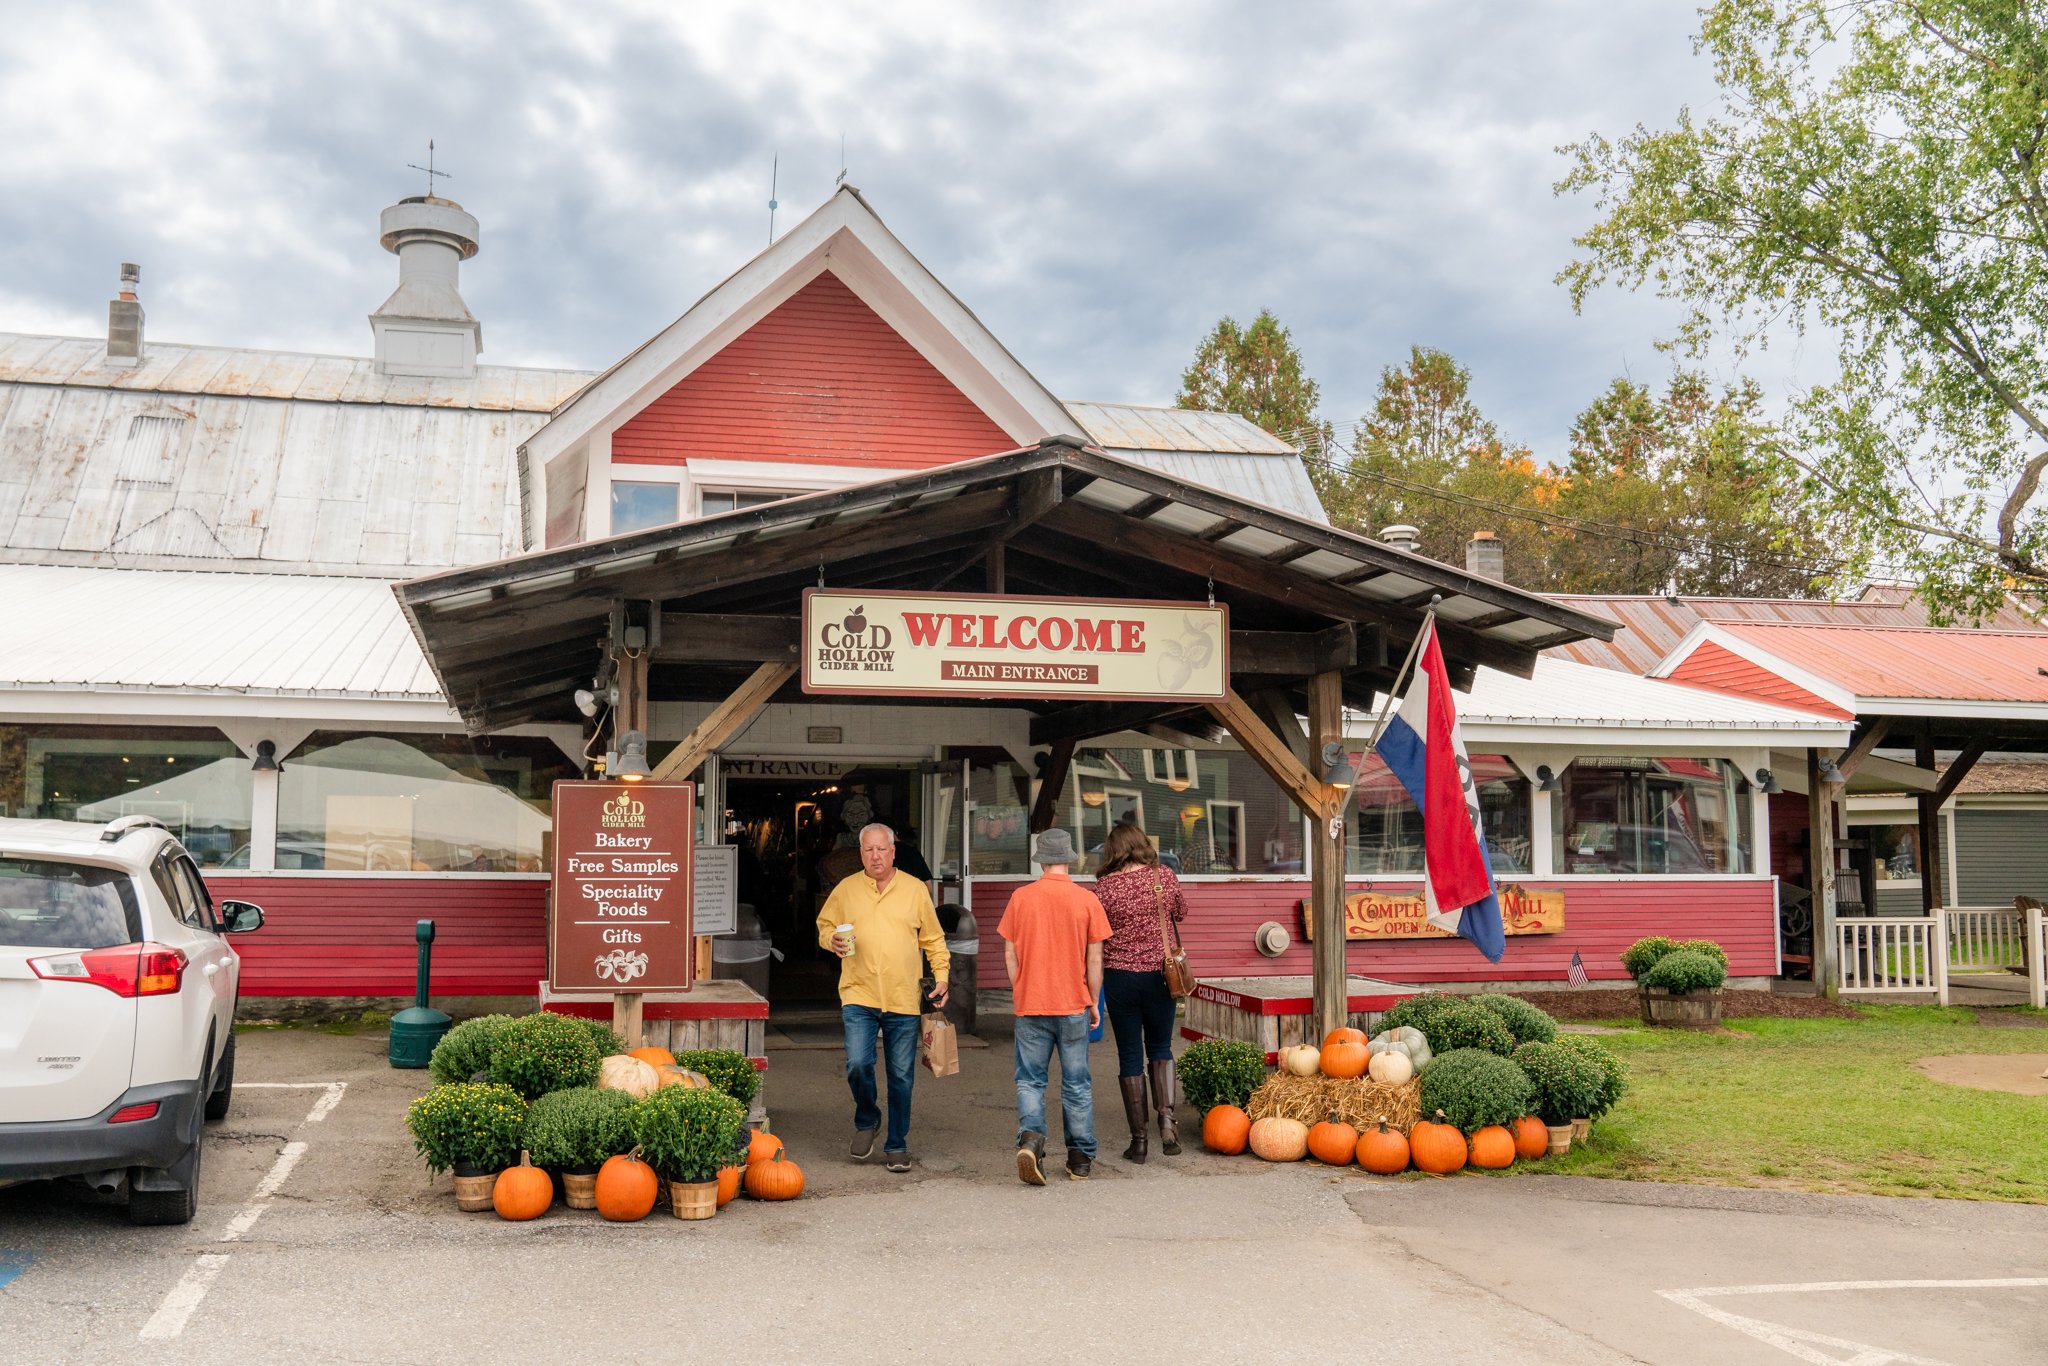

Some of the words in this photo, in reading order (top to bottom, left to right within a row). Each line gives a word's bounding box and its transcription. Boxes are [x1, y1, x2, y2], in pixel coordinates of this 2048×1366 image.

[821, 622, 892, 650] COLD
[901, 611, 1147, 653] WELCOME
[818, 649, 895, 663] HOLLOW
[820, 662, 859, 671] CIDER
[864, 662, 895, 672] MILL
[952, 664, 995, 678] MAIN
[1001, 666, 1088, 681] ENTRANCE
[728, 761, 841, 776] NTRANCE
[603, 800, 644, 816] COLD
[595, 832, 652, 849] Bakery
[568, 858, 604, 872] Free
[612, 858, 678, 876] Samples
[582, 884, 664, 900] Speciality
[598, 902, 648, 916] Foods
[1357, 897, 1427, 922] COMPLE
[1504, 892, 1546, 919] MILL
[1384, 922, 1419, 934] OPEN
[1425, 922, 1436, 932] to
[602, 929, 642, 944] Gifts
[1198, 986, 1214, 1001] COLD
[1215, 990, 1240, 1008] HOLLOW
